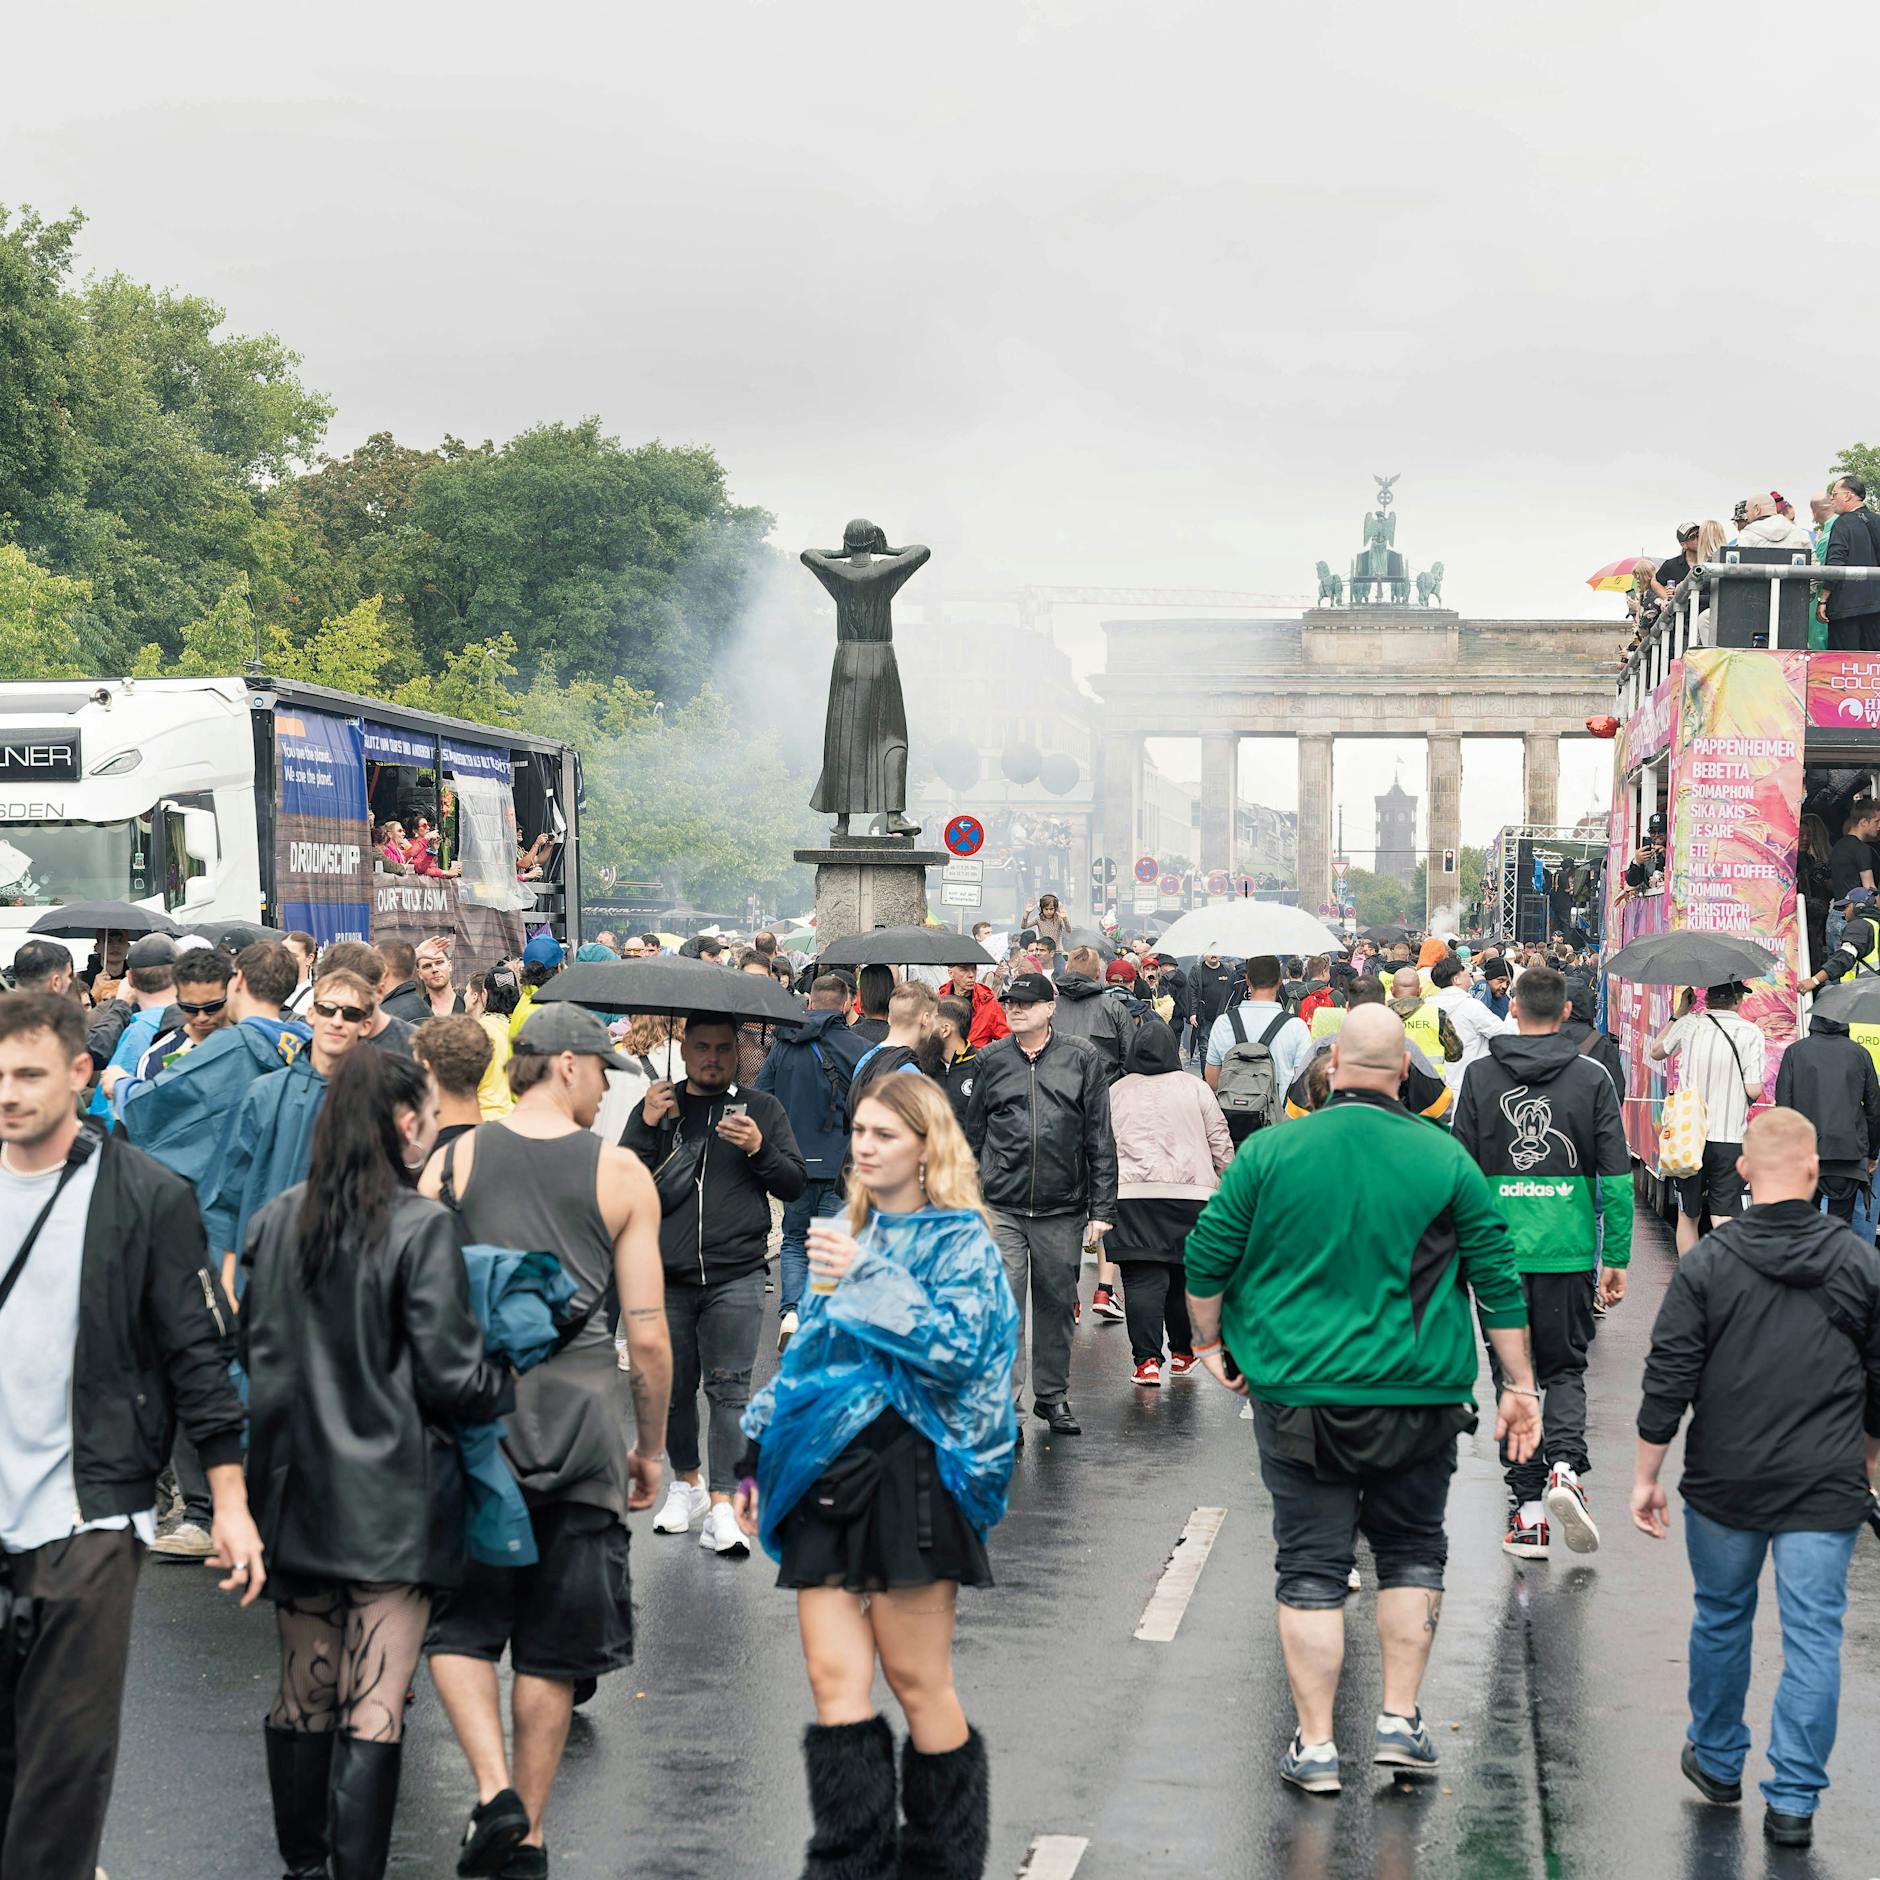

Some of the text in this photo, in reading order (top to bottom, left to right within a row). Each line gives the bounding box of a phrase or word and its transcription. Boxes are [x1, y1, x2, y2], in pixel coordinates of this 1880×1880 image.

[1693, 738, 1795, 757] PAPPENHEIMER
[0, 746, 72, 767] NER
[284, 765, 294, 782] We
[1692, 762, 1750, 779] BEBETTA
[1691, 784, 1754, 799] SOMAPHON
[1690, 803, 1746, 819] SIKA AKIS
[1689, 843, 1709, 857] ETE
[1733, 864, 1775, 879] COFFEE
[1688, 883, 1732, 897] DOMINO
[1687, 902, 1750, 917] CHRISTOPH
[1499, 1182, 1555, 1197] adidas
